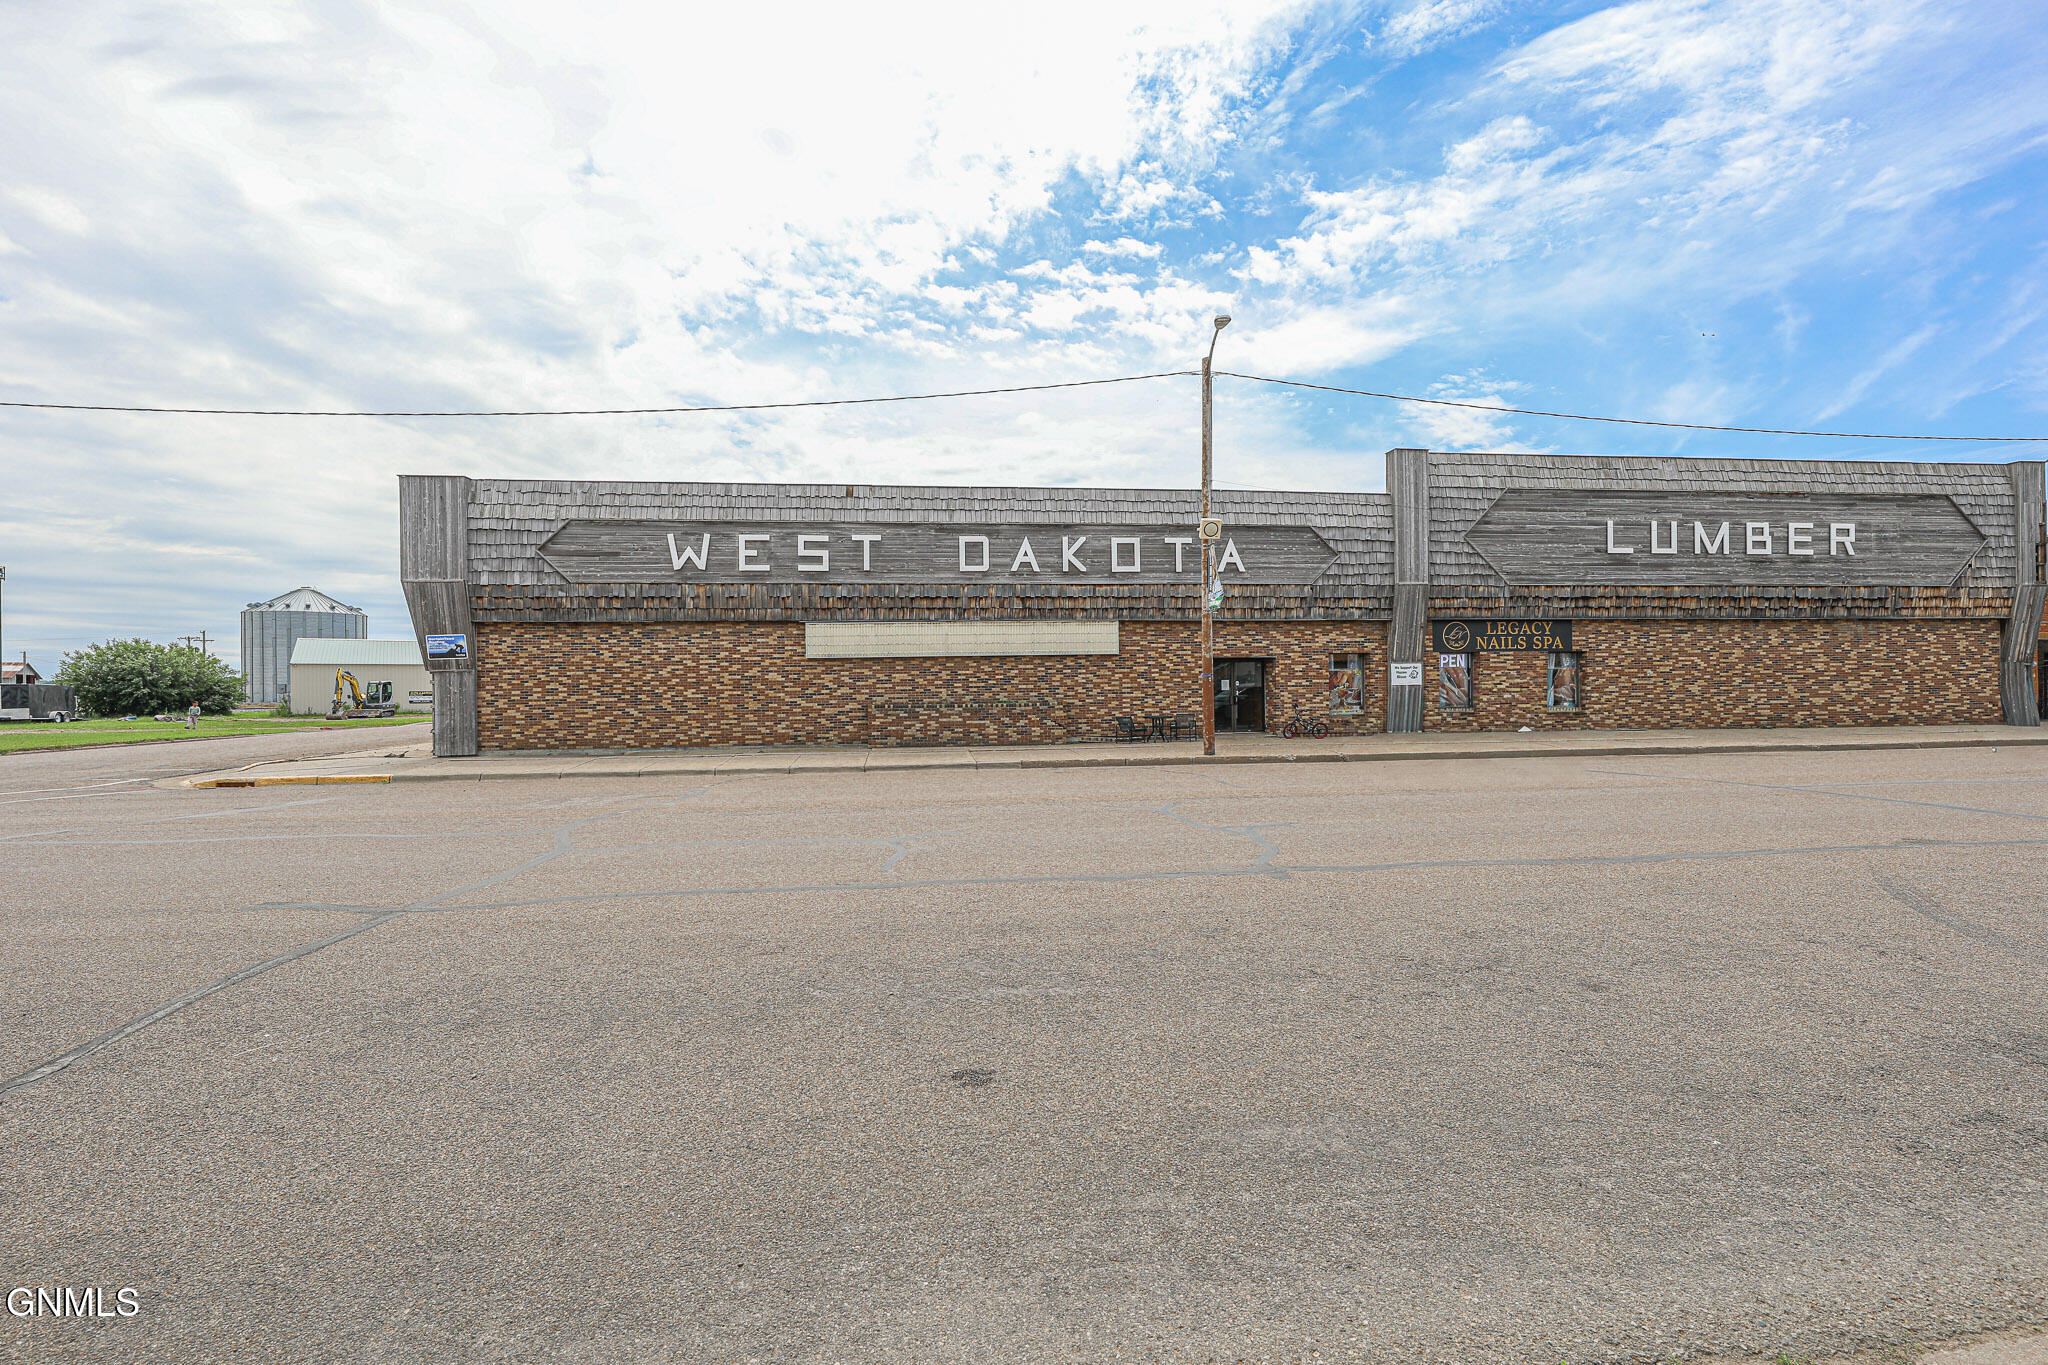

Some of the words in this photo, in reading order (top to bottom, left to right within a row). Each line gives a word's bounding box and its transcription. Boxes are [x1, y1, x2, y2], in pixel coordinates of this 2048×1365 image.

[1606, 520, 1857, 556] LUMBER
[666, 533, 882, 572] WEST
[958, 535, 1247, 573] DAKOTA
[1486, 621, 1553, 635] LEGACY
[1476, 636, 1527, 650] NAILS
[1533, 636, 1564, 649] SPA
[1440, 654, 1465, 668] PEN
